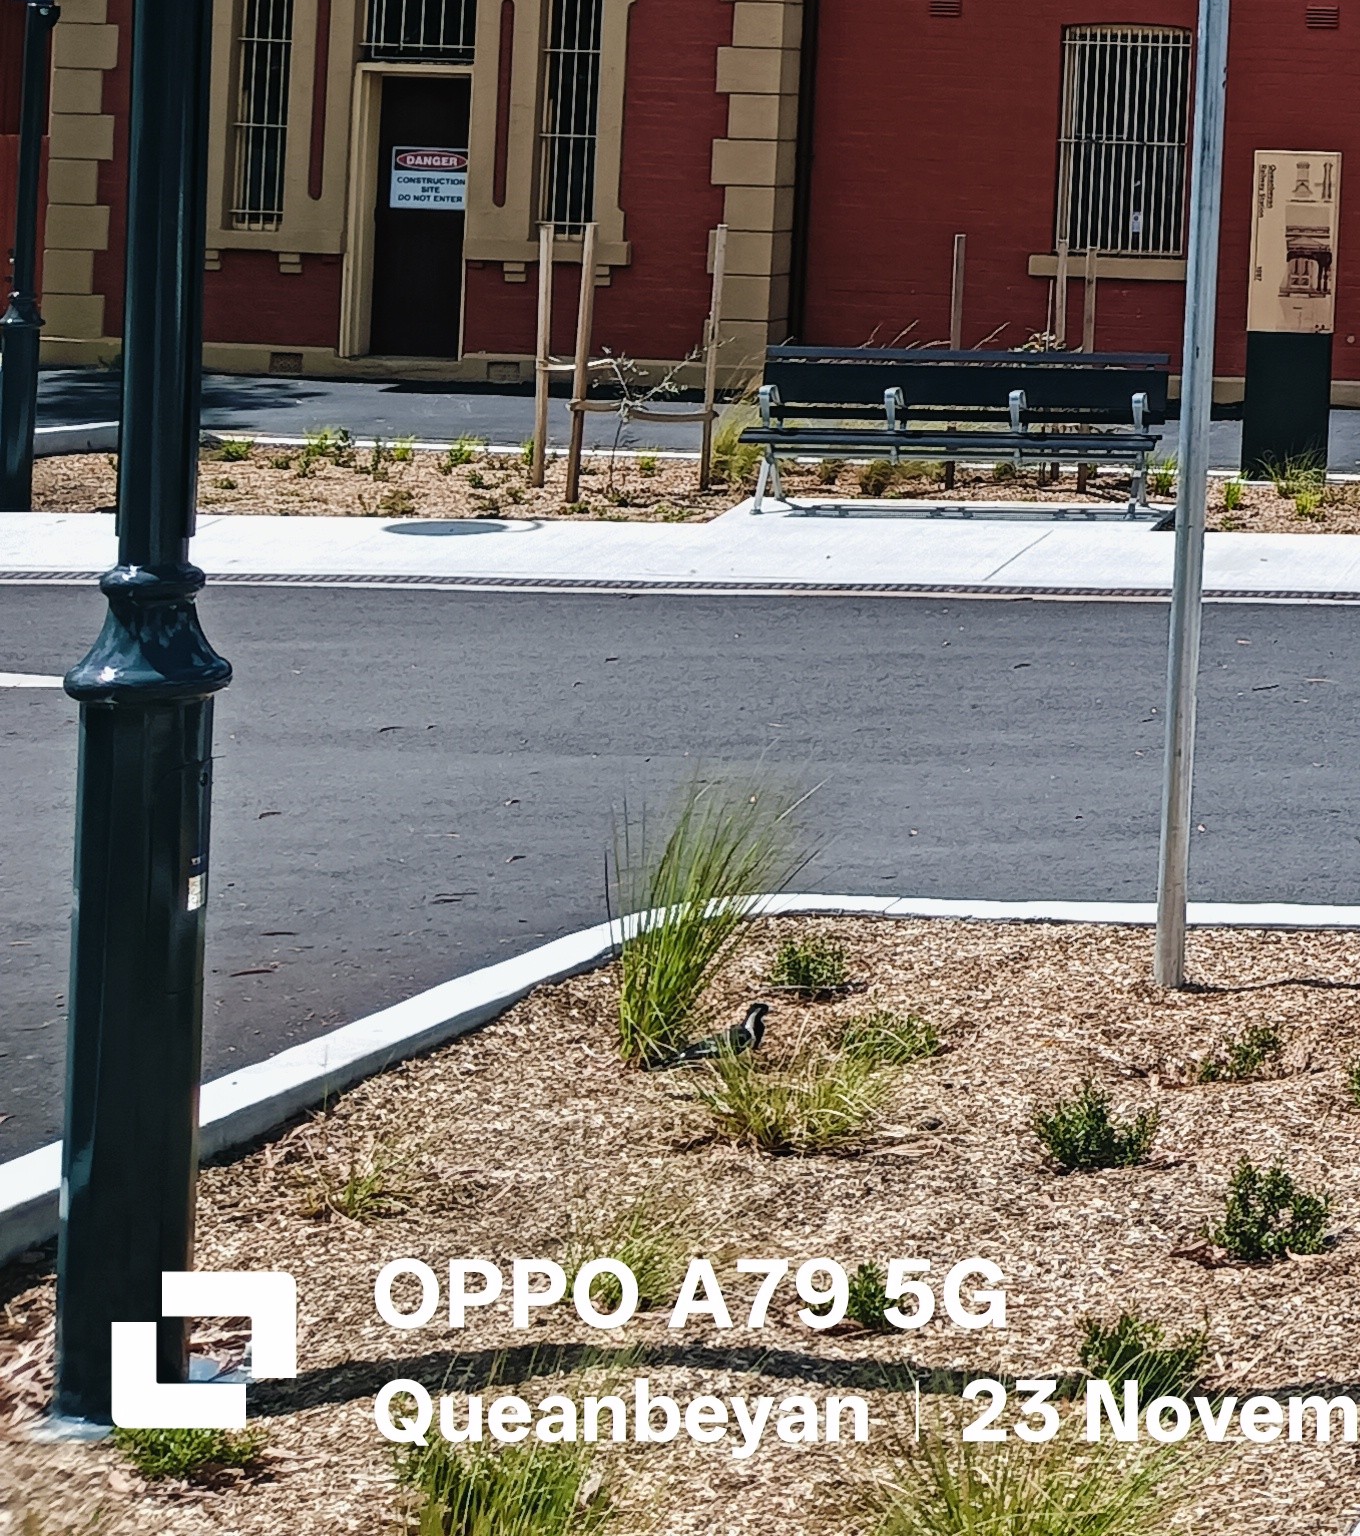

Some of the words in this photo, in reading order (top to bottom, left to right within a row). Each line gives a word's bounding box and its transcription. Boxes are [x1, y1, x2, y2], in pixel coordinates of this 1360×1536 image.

[406, 155, 458, 167] DANGER
[396, 176, 466, 186] CONSTRUCTION
[421, 186, 440, 194] SITE
[413, 194, 431, 202] NOT
[433, 195, 463, 203] ENTER
